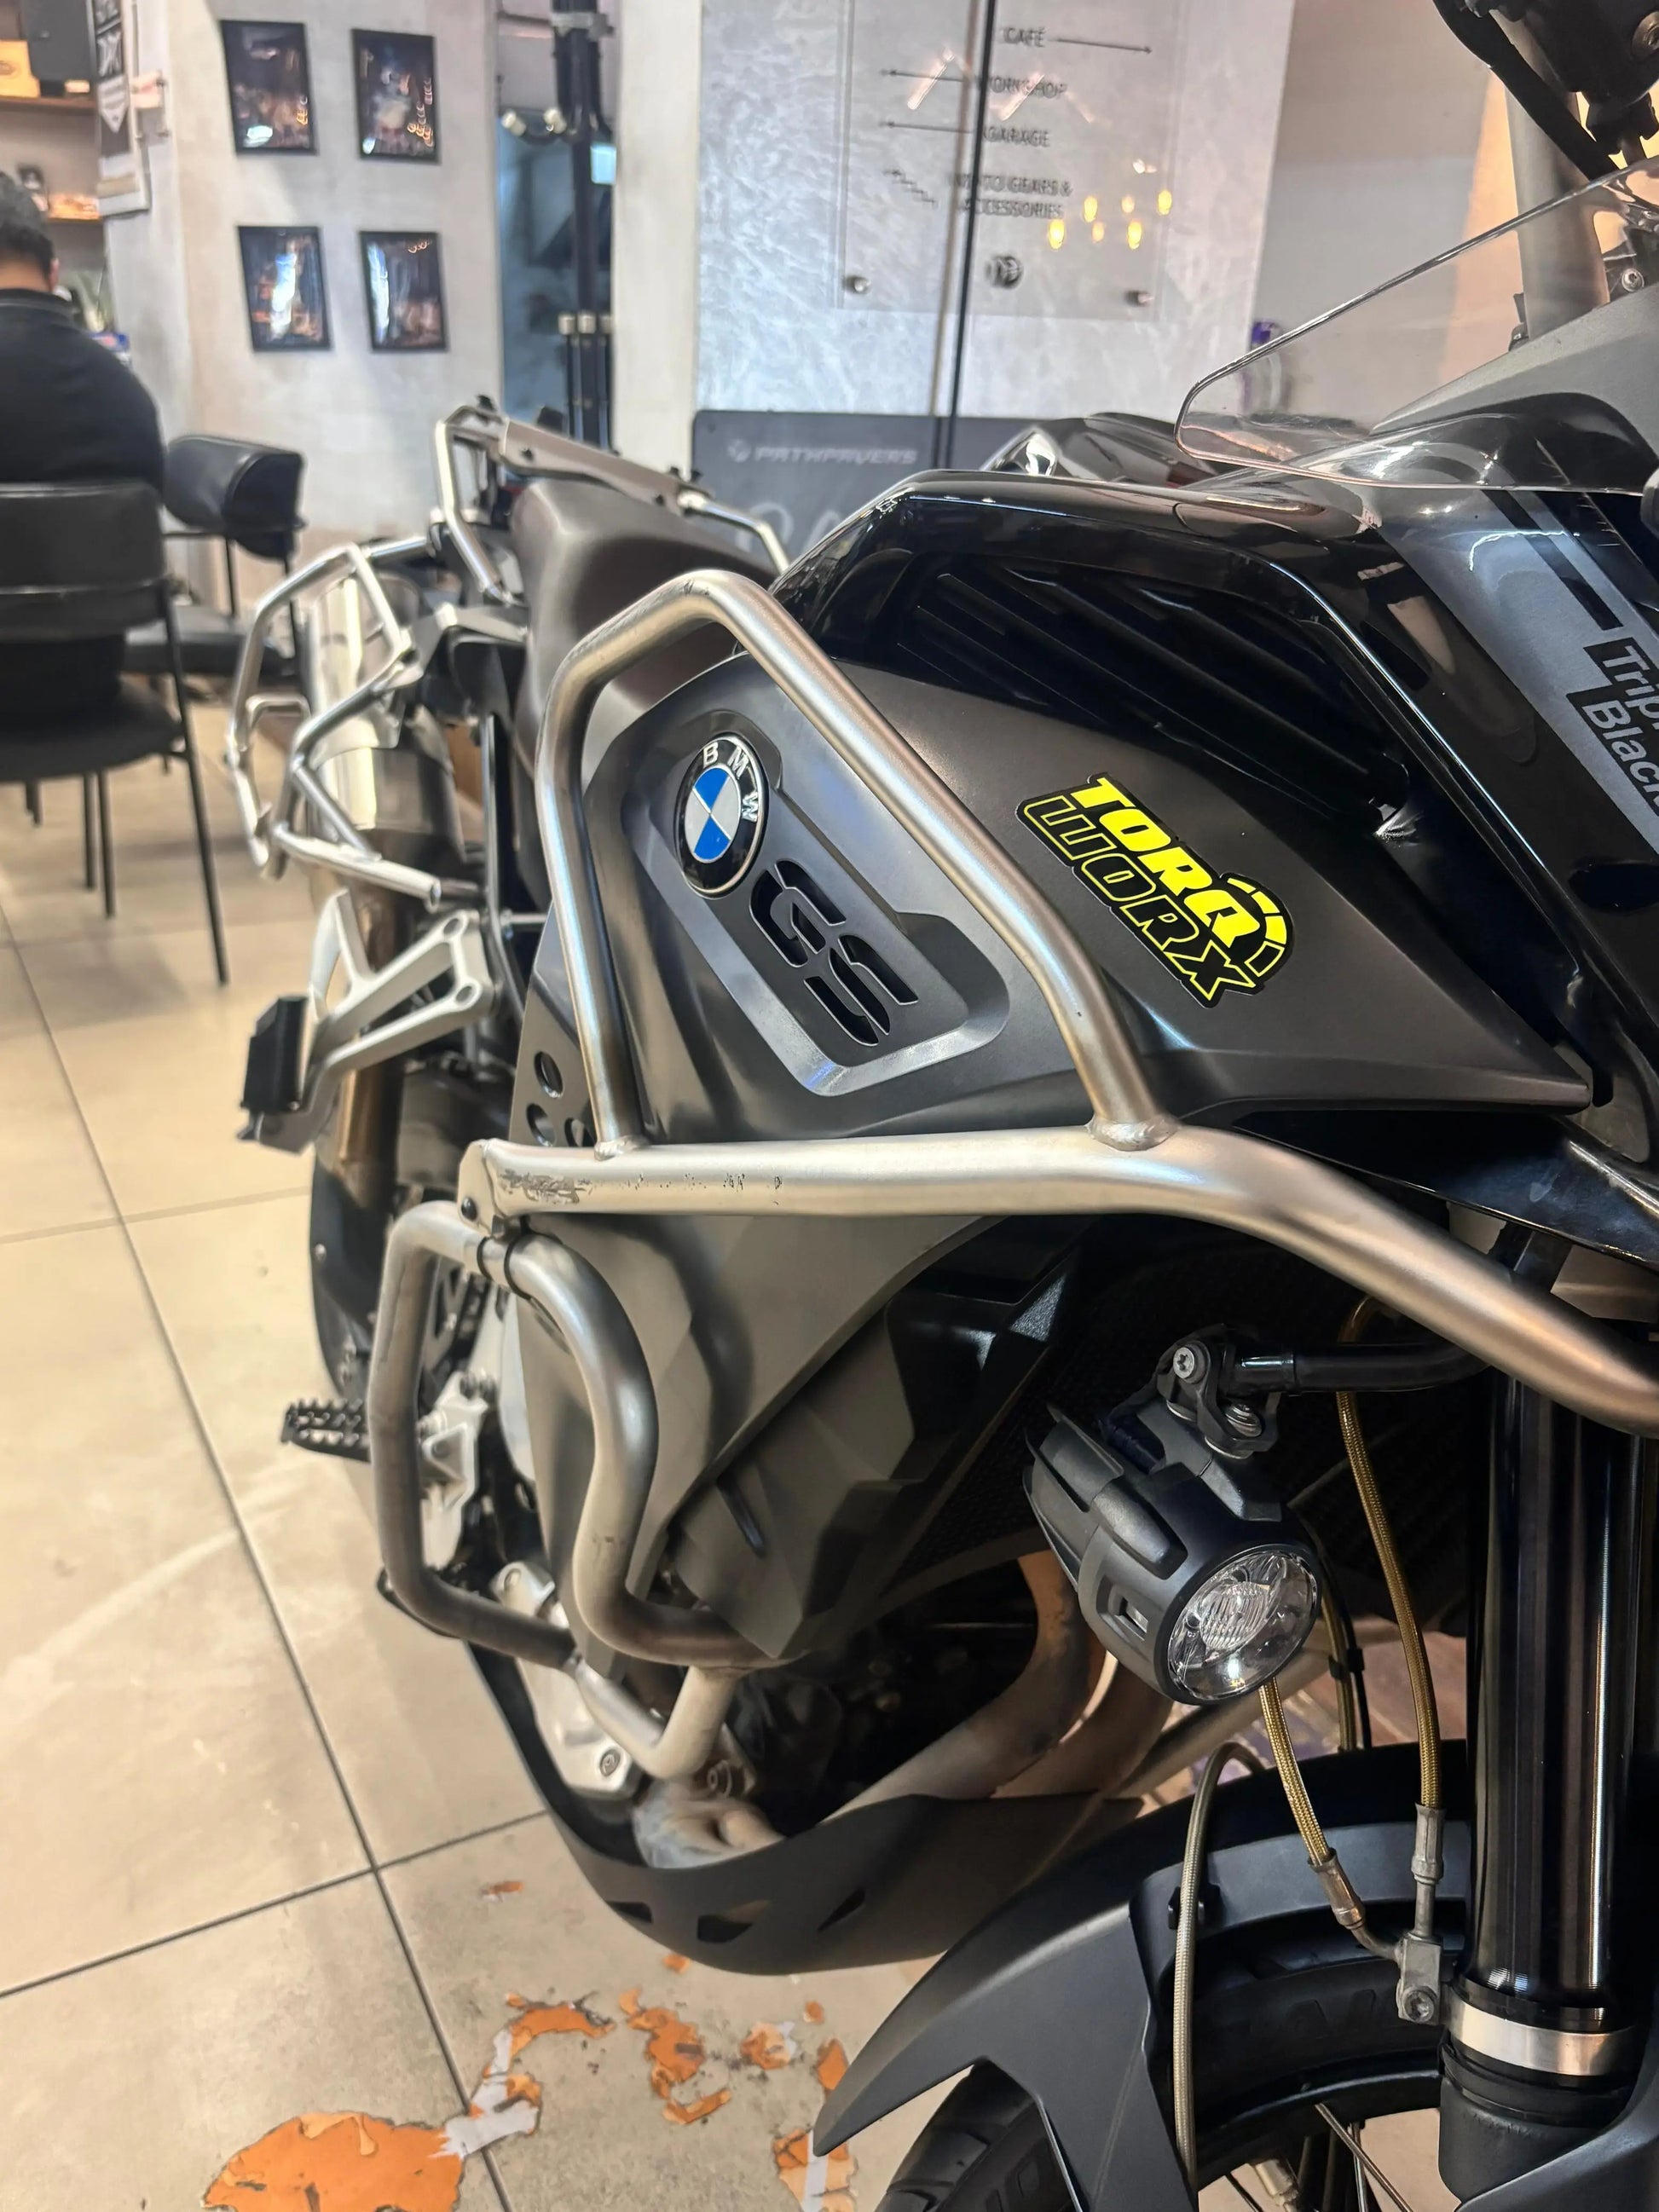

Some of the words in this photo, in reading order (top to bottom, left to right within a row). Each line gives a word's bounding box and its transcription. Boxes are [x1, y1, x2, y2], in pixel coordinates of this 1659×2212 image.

[983, 125, 1051, 147] GARAGE
[950, 173, 1005, 192] MTO
[1060, 181, 1073, 197] &
[962, 198, 1064, 219] ACESSORIES
[1603, 645, 1659, 730] Trip
[702, 741, 760, 823] BMW
[1023, 794, 1257, 1002] WORX
[1071, 777, 1262, 949] TORQ
[749, 859, 920, 1048] GS
